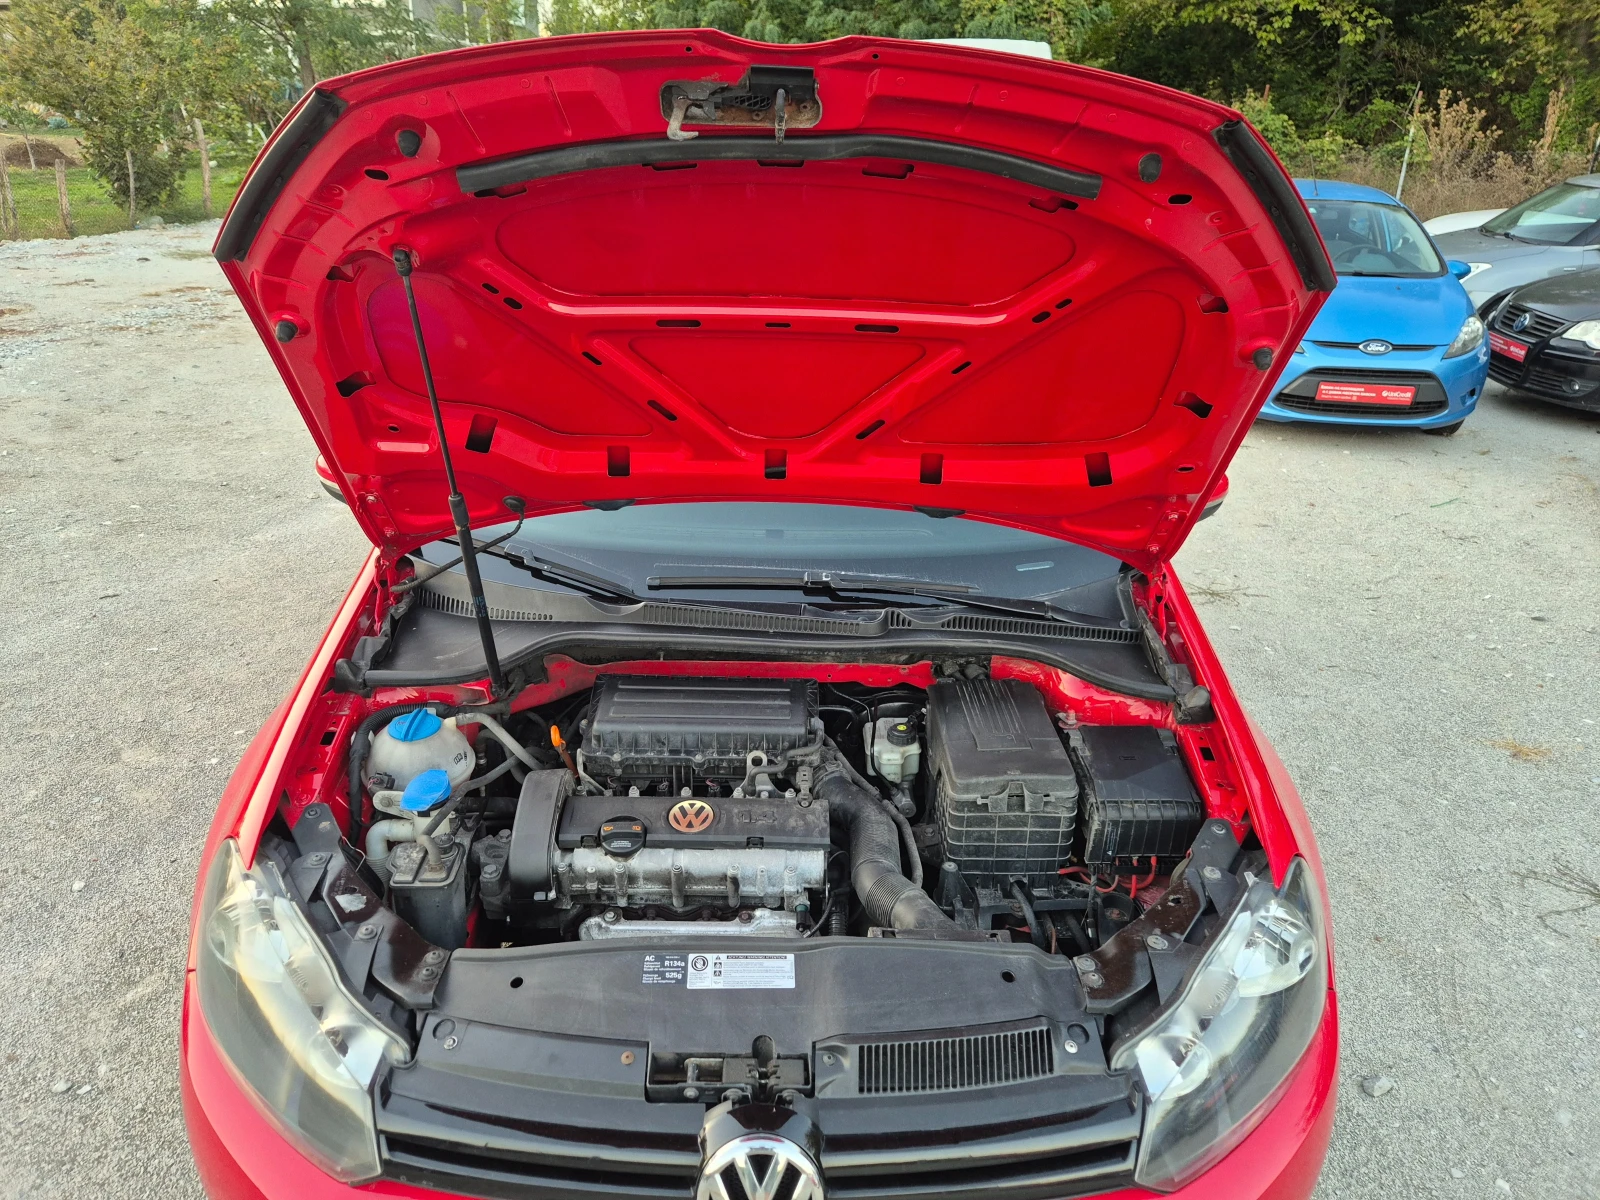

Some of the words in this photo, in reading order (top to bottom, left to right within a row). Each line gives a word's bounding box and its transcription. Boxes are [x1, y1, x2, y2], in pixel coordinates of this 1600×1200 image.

[1367, 342, 1386, 352] Ford
[669, 800, 714, 833] VW
[665, 971, 682, 979] 525g
